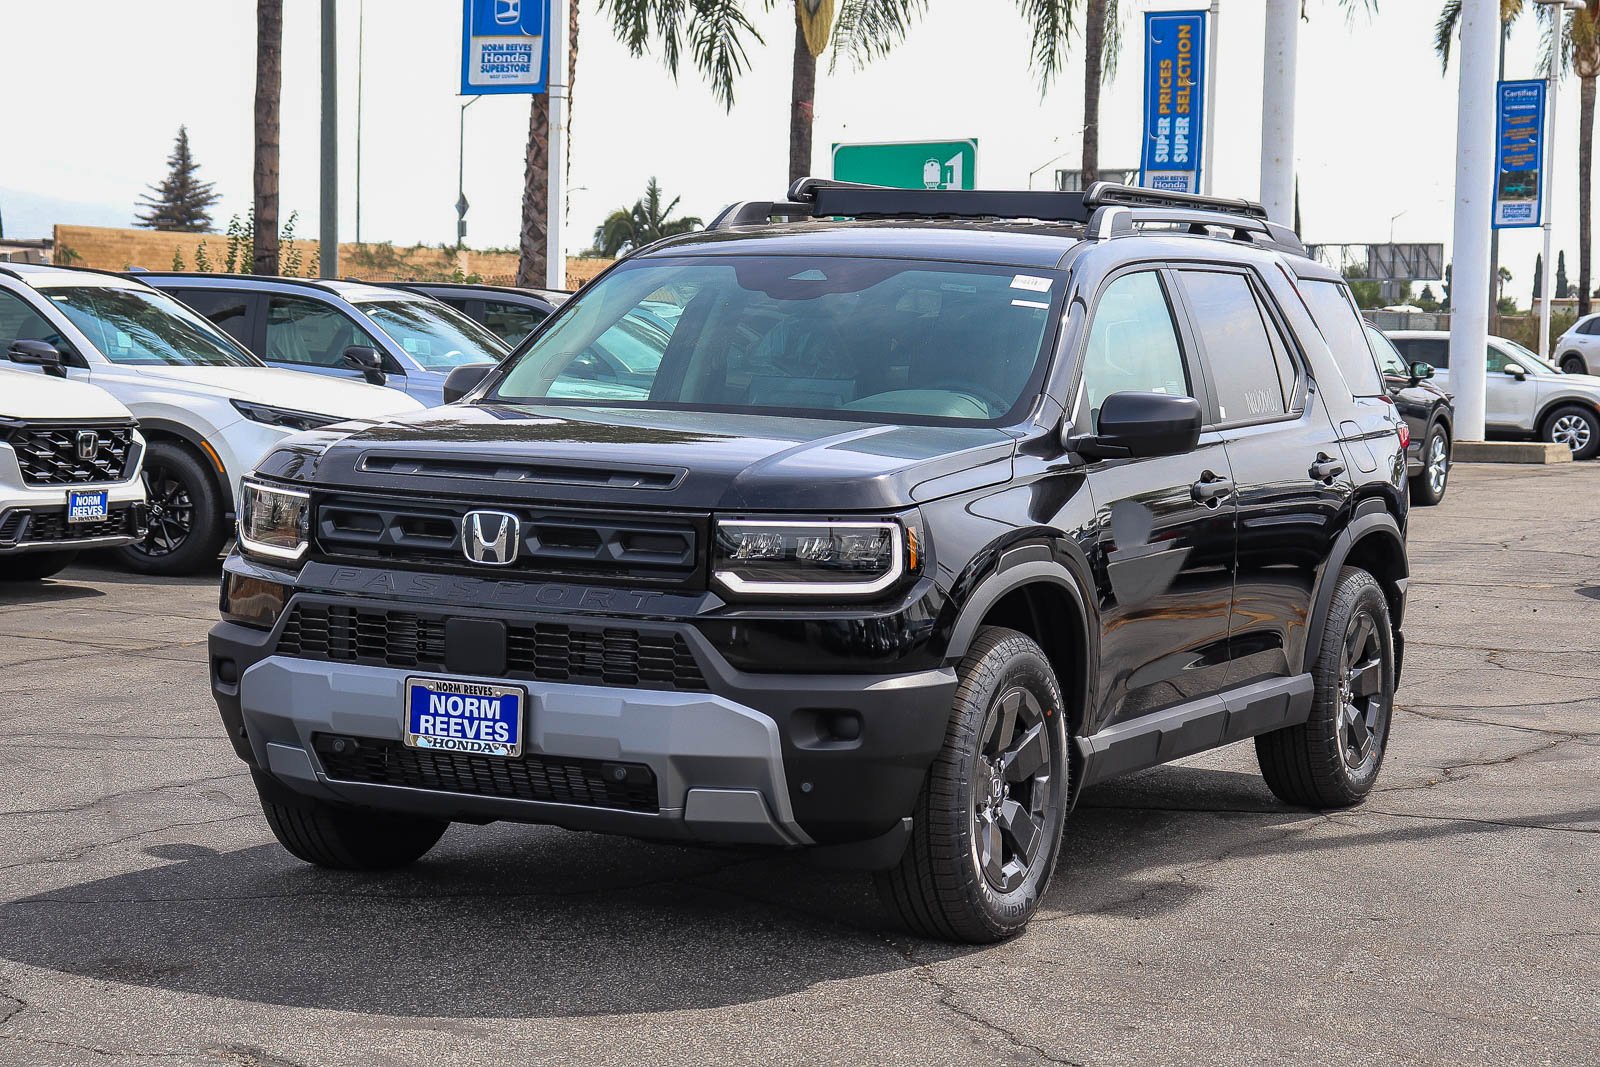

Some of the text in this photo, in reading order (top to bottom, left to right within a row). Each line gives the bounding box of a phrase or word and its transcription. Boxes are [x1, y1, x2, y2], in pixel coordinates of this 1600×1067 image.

[484, 53, 528, 62] Honda
[480, 64, 530, 73] SUPERSTORE
[1174, 25, 1191, 163] SUPER SELECTION
[1155, 59, 1173, 163] SUPER PRICES
[75, 496, 101, 506] NORM
[72, 505, 103, 516] REEVES
[327, 567, 664, 610] PASSPORT
[435, 682, 493, 696] NORM REEVES
[429, 694, 501, 719] NORM
[419, 715, 509, 741] REEVES
[432, 737, 496, 753] HONDA
